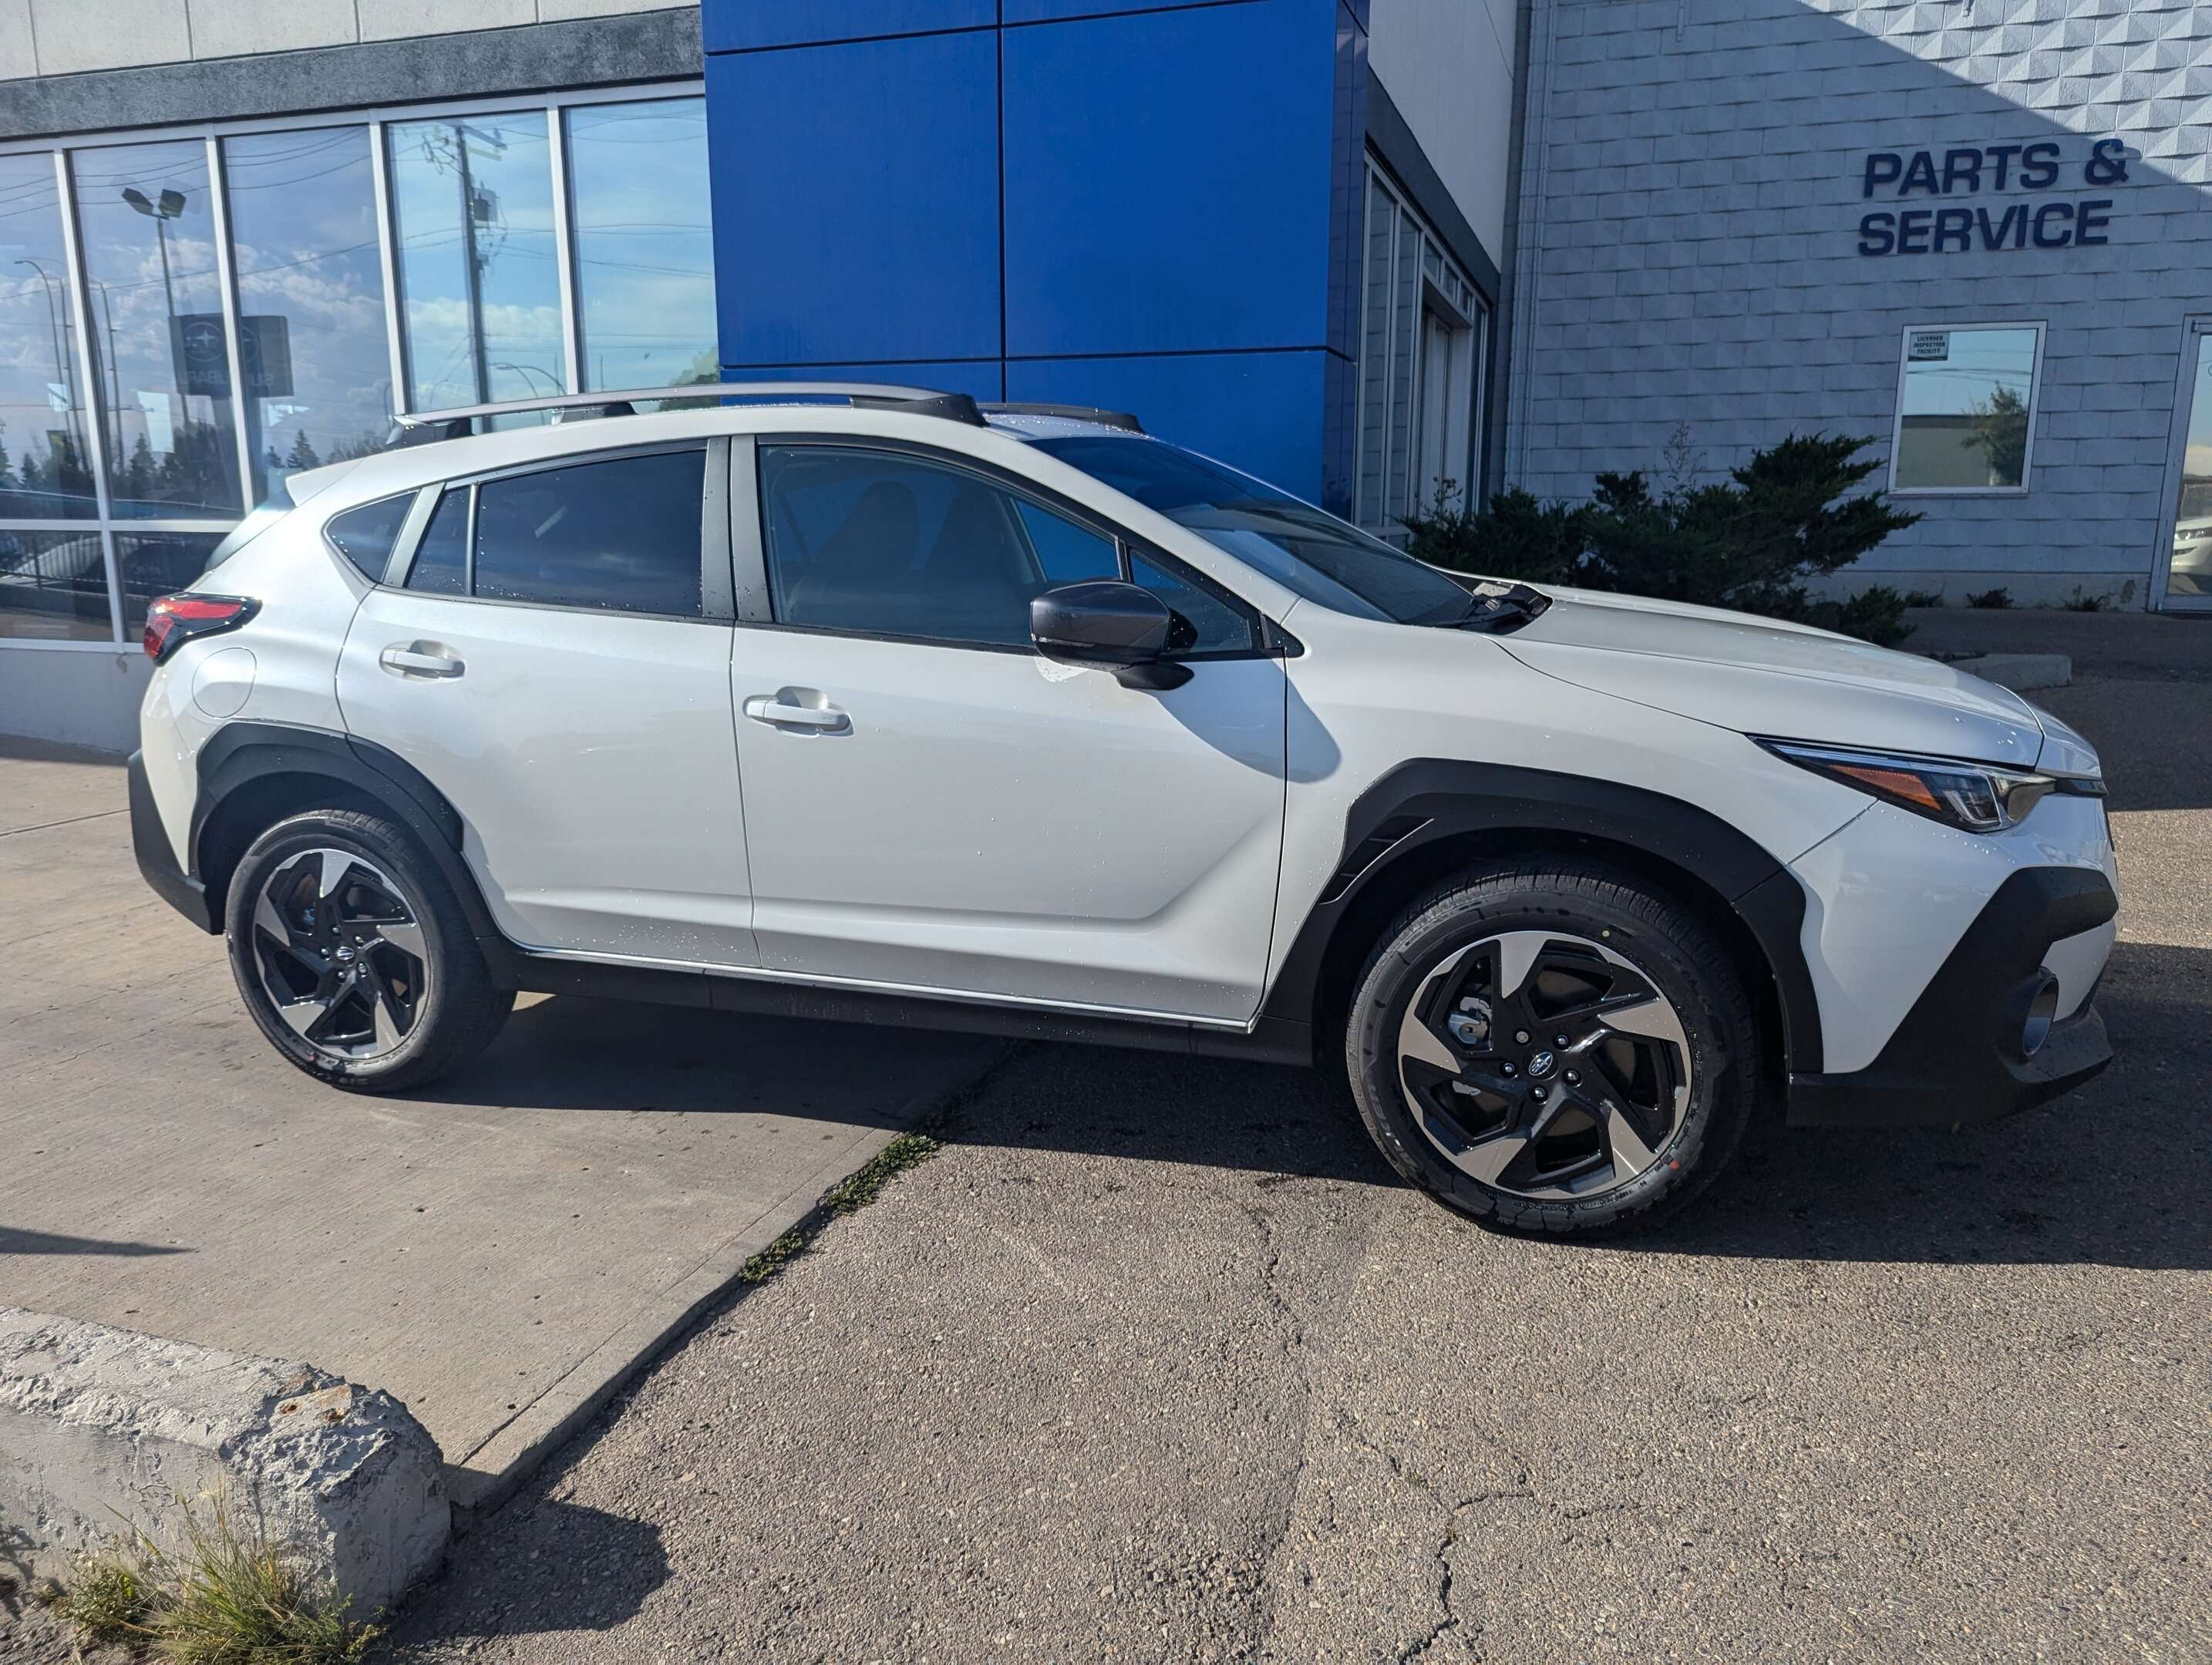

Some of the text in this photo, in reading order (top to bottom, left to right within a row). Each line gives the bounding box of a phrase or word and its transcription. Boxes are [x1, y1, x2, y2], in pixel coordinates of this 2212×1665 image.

[1863, 138, 2130, 198] PARTS &
[1857, 199, 2114, 257] SERVICE
